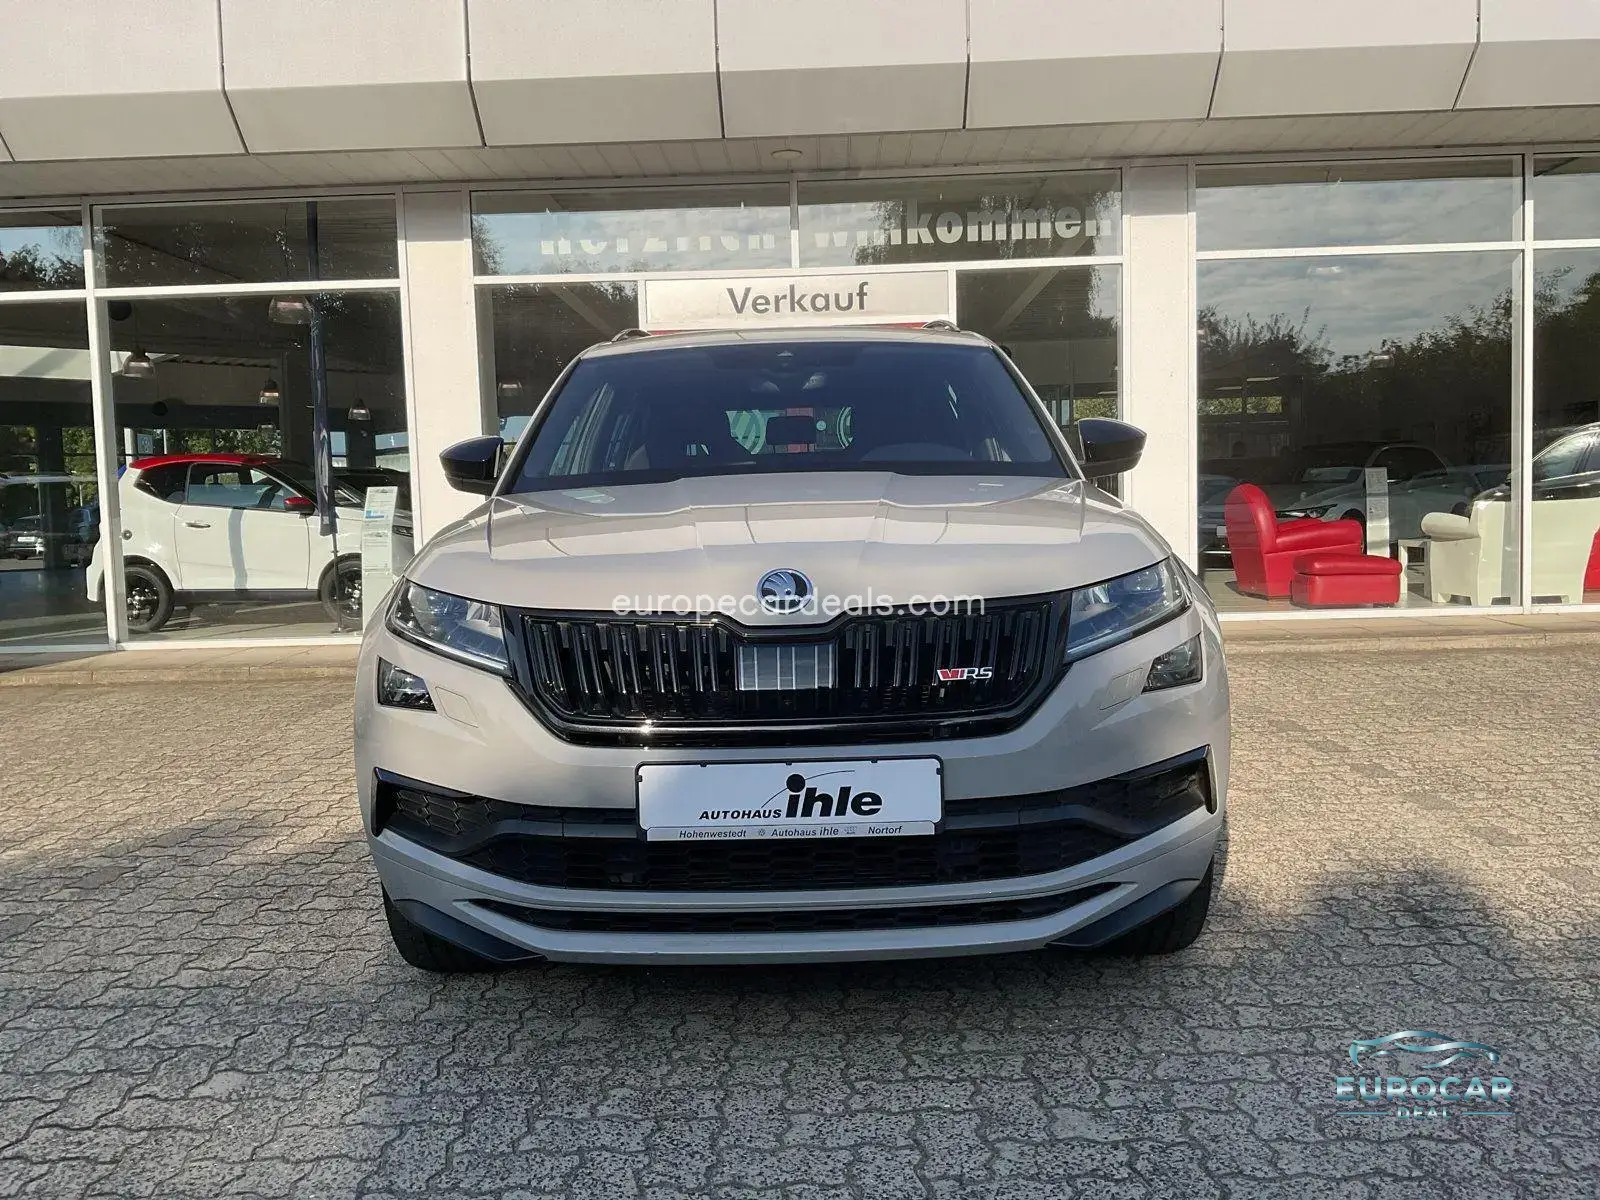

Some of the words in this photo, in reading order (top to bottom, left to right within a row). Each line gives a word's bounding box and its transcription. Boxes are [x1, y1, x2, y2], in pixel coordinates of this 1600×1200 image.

[727, 281, 869, 315] Verkauf
[698, 808, 782, 821] AUTOHAUS
[784, 773, 883, 819] ihle
[679, 829, 747, 839] Hohenwestedt
[771, 827, 817, 837] Autohaus
[819, 826, 839, 836] ihle
[868, 825, 903, 835] Nortorf
